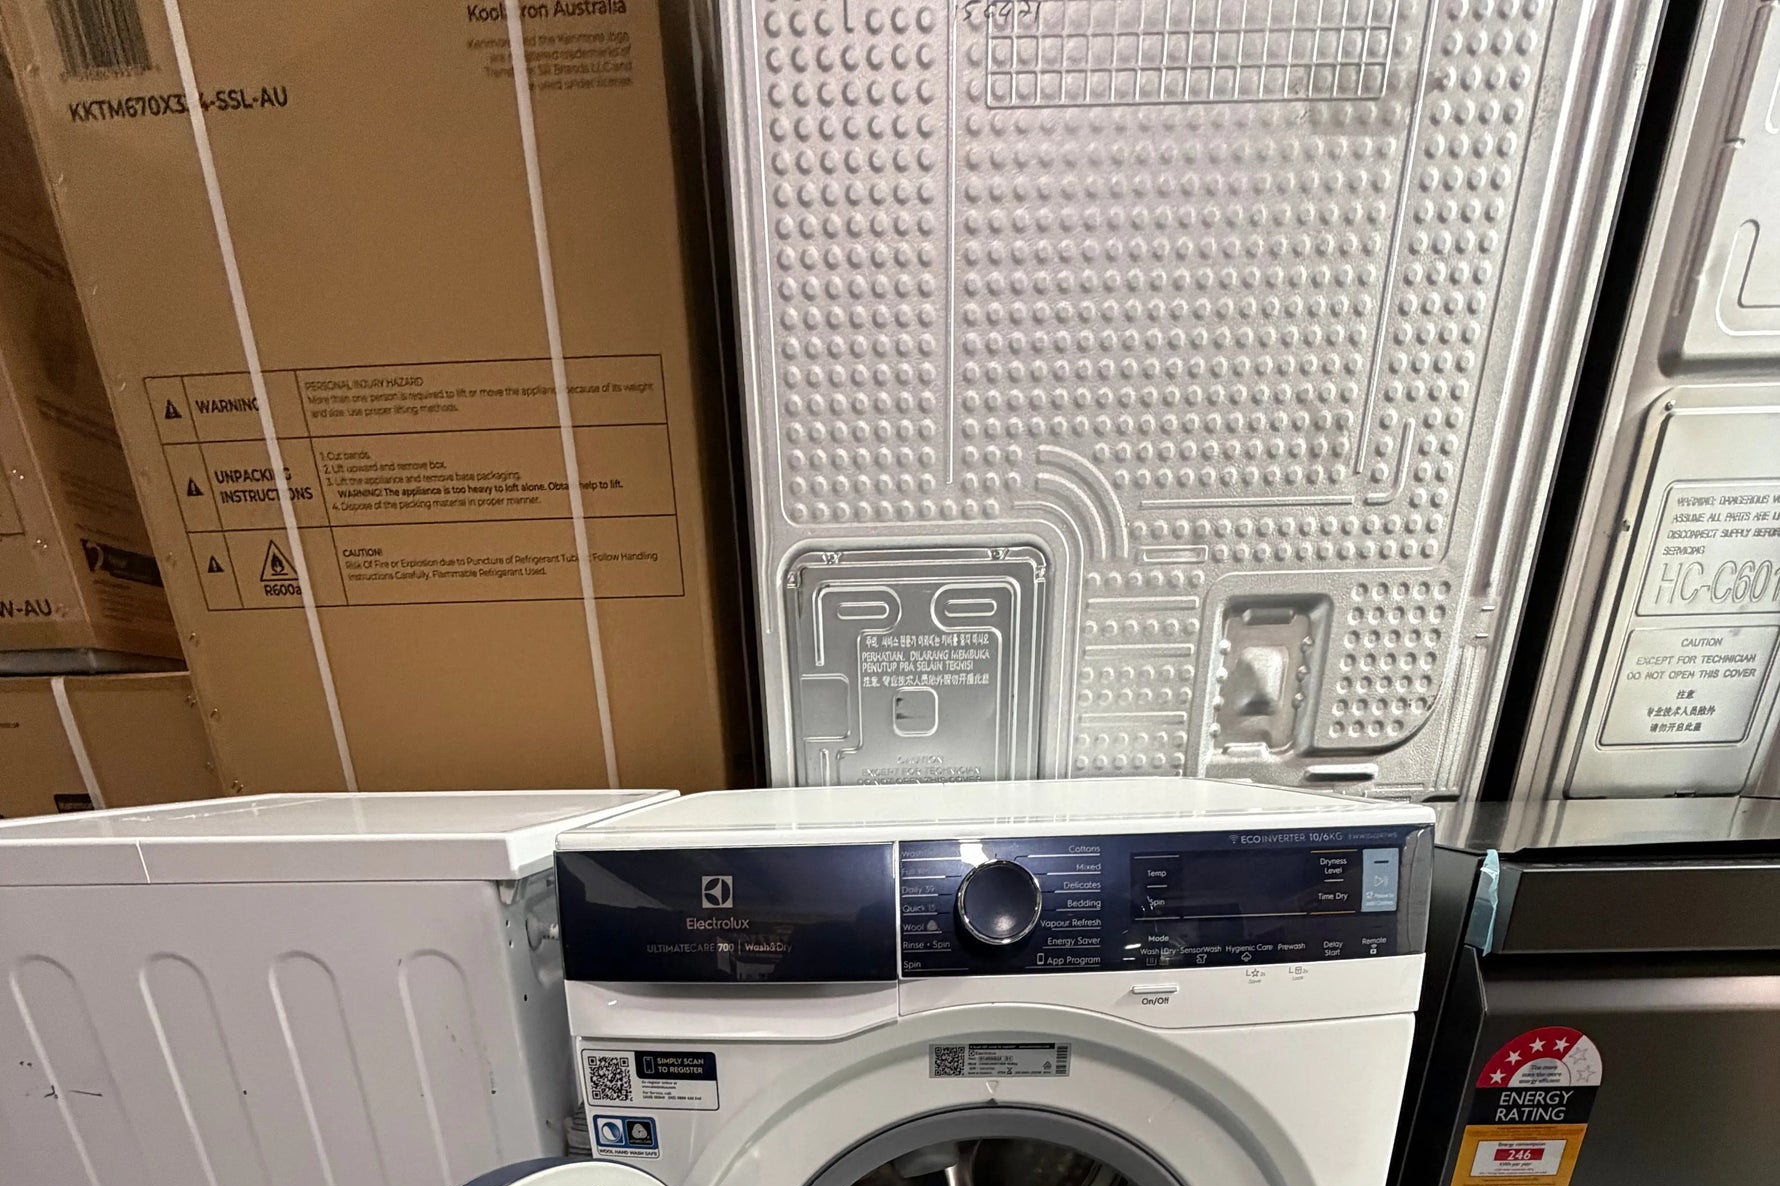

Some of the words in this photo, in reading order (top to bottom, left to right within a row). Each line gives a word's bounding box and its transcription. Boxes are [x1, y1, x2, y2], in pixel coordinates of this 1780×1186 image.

[468, 4, 549, 22] Koolron
[553, 0, 626, 17] Australia
[69, 86, 288, 123] KKTM670X34-SSL-AU
[215, 468, 292, 484] UNPACKIG
[384, 487, 400, 497] The
[452, 485, 466, 494] too
[468, 485, 493, 494] heavy
[548, 481, 569, 491] Obta
[598, 480, 608, 489] to
[219, 487, 313, 504] INSTRUCTONS
[1707, 513, 1721, 522] ALL
[1724, 512, 1751, 521] PARTS
[1753, 511, 1771, 521] ARE
[1720, 528, 1752, 538] SUPPLY
[1681, 638, 1723, 648] CAUTION
[910, 650, 948, 660] DILARANG
[951, 649, 990, 660] MEMBUKA
[1636, 656, 1675, 666] EXCEPT
[1677, 655, 1697, 664] FOR
[1701, 654, 1756, 664] TECHNICIAN
[862, 662, 897, 672] PENUTUP
[917, 661, 943, 671] SELAIN
[946, 660, 973, 670] TEKNISI
[1627, 672, 1640, 680] DO
[1645, 671, 1665, 680] NOT
[1668, 670, 1695, 680] OPEN
[1700, 669, 1720, 678] THIS
[1723, 668, 1756, 678] COVER
[1241, 834, 1306, 844] ECOINVERTER
[1309, 832, 1343, 842] 10/6KG
[1068, 845, 1101, 853] Cottons
[1320, 858, 1347, 866] Dryness
[1147, 870, 1166, 878] Temp
[1063, 881, 1101, 889] Delicates
[1336, 893, 1348, 901] Dry
[1067, 899, 1101, 909] Bedding
[686, 917, 750, 929] Electrolux
[903, 923, 924, 931] Wool
[1040, 919, 1070, 928] Vapour
[1072, 918, 1102, 927] Refresh
[903, 941, 924, 949] Rinse
[933, 940, 950, 949] Spin
[1047, 937, 1076, 947] Energy
[1323, 941, 1343, 949] Delay
[646, 943, 715, 953] ULTIMATECARE
[718, 943, 734, 952] 700
[745, 942, 792, 953] Wash&Dry
[1180, 946, 1222, 954] SensorWash
[1226, 944, 1255, 953] Hygienic
[903, 961, 921, 969] Spin
[1047, 956, 1062, 967] App
[1063, 955, 1101, 966] Program
[1142, 996, 1170, 1006] On/Off
[1499, 1090, 1574, 1105] ENERGY
[1495, 1107, 1566, 1122] RATING
[1507, 1150, 1531, 1160] 246
